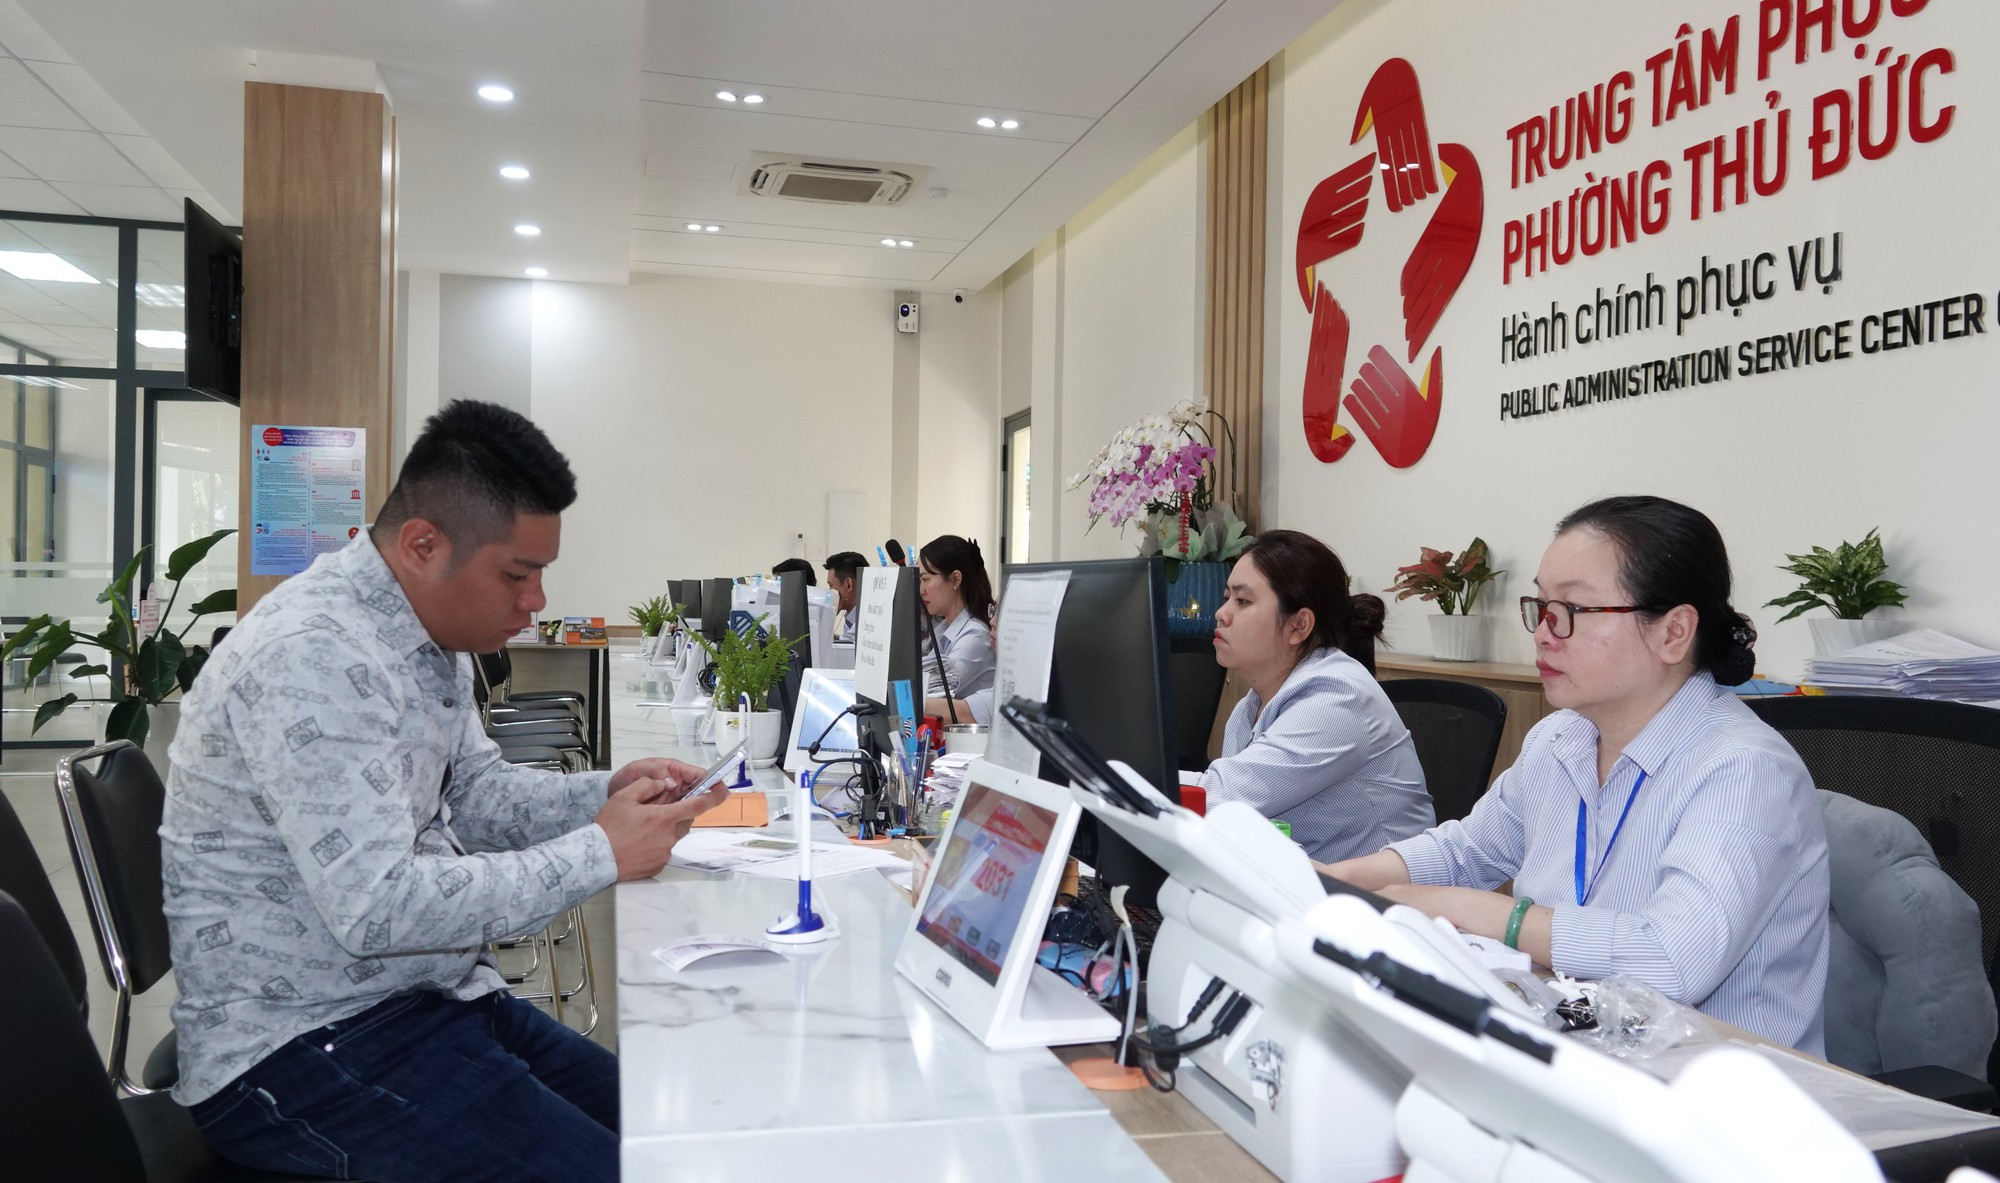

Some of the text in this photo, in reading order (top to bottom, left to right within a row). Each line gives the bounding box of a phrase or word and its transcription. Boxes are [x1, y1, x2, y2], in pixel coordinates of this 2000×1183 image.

[1503, 46, 1956, 285] PHƯỜNG THỦ ĐỨC
[1507, 71, 1635, 189] TRUNG
[1645, 15, 1741, 127] TÂM
[1500, 382, 1560, 420] PUBLIC
[1563, 345, 1732, 409] ADMINISTRATION
[1738, 319, 1853, 376] SERVICE
[1861, 292, 1985, 354] CENTER
[1502, 232, 1843, 364] Hành chính phục vụ
